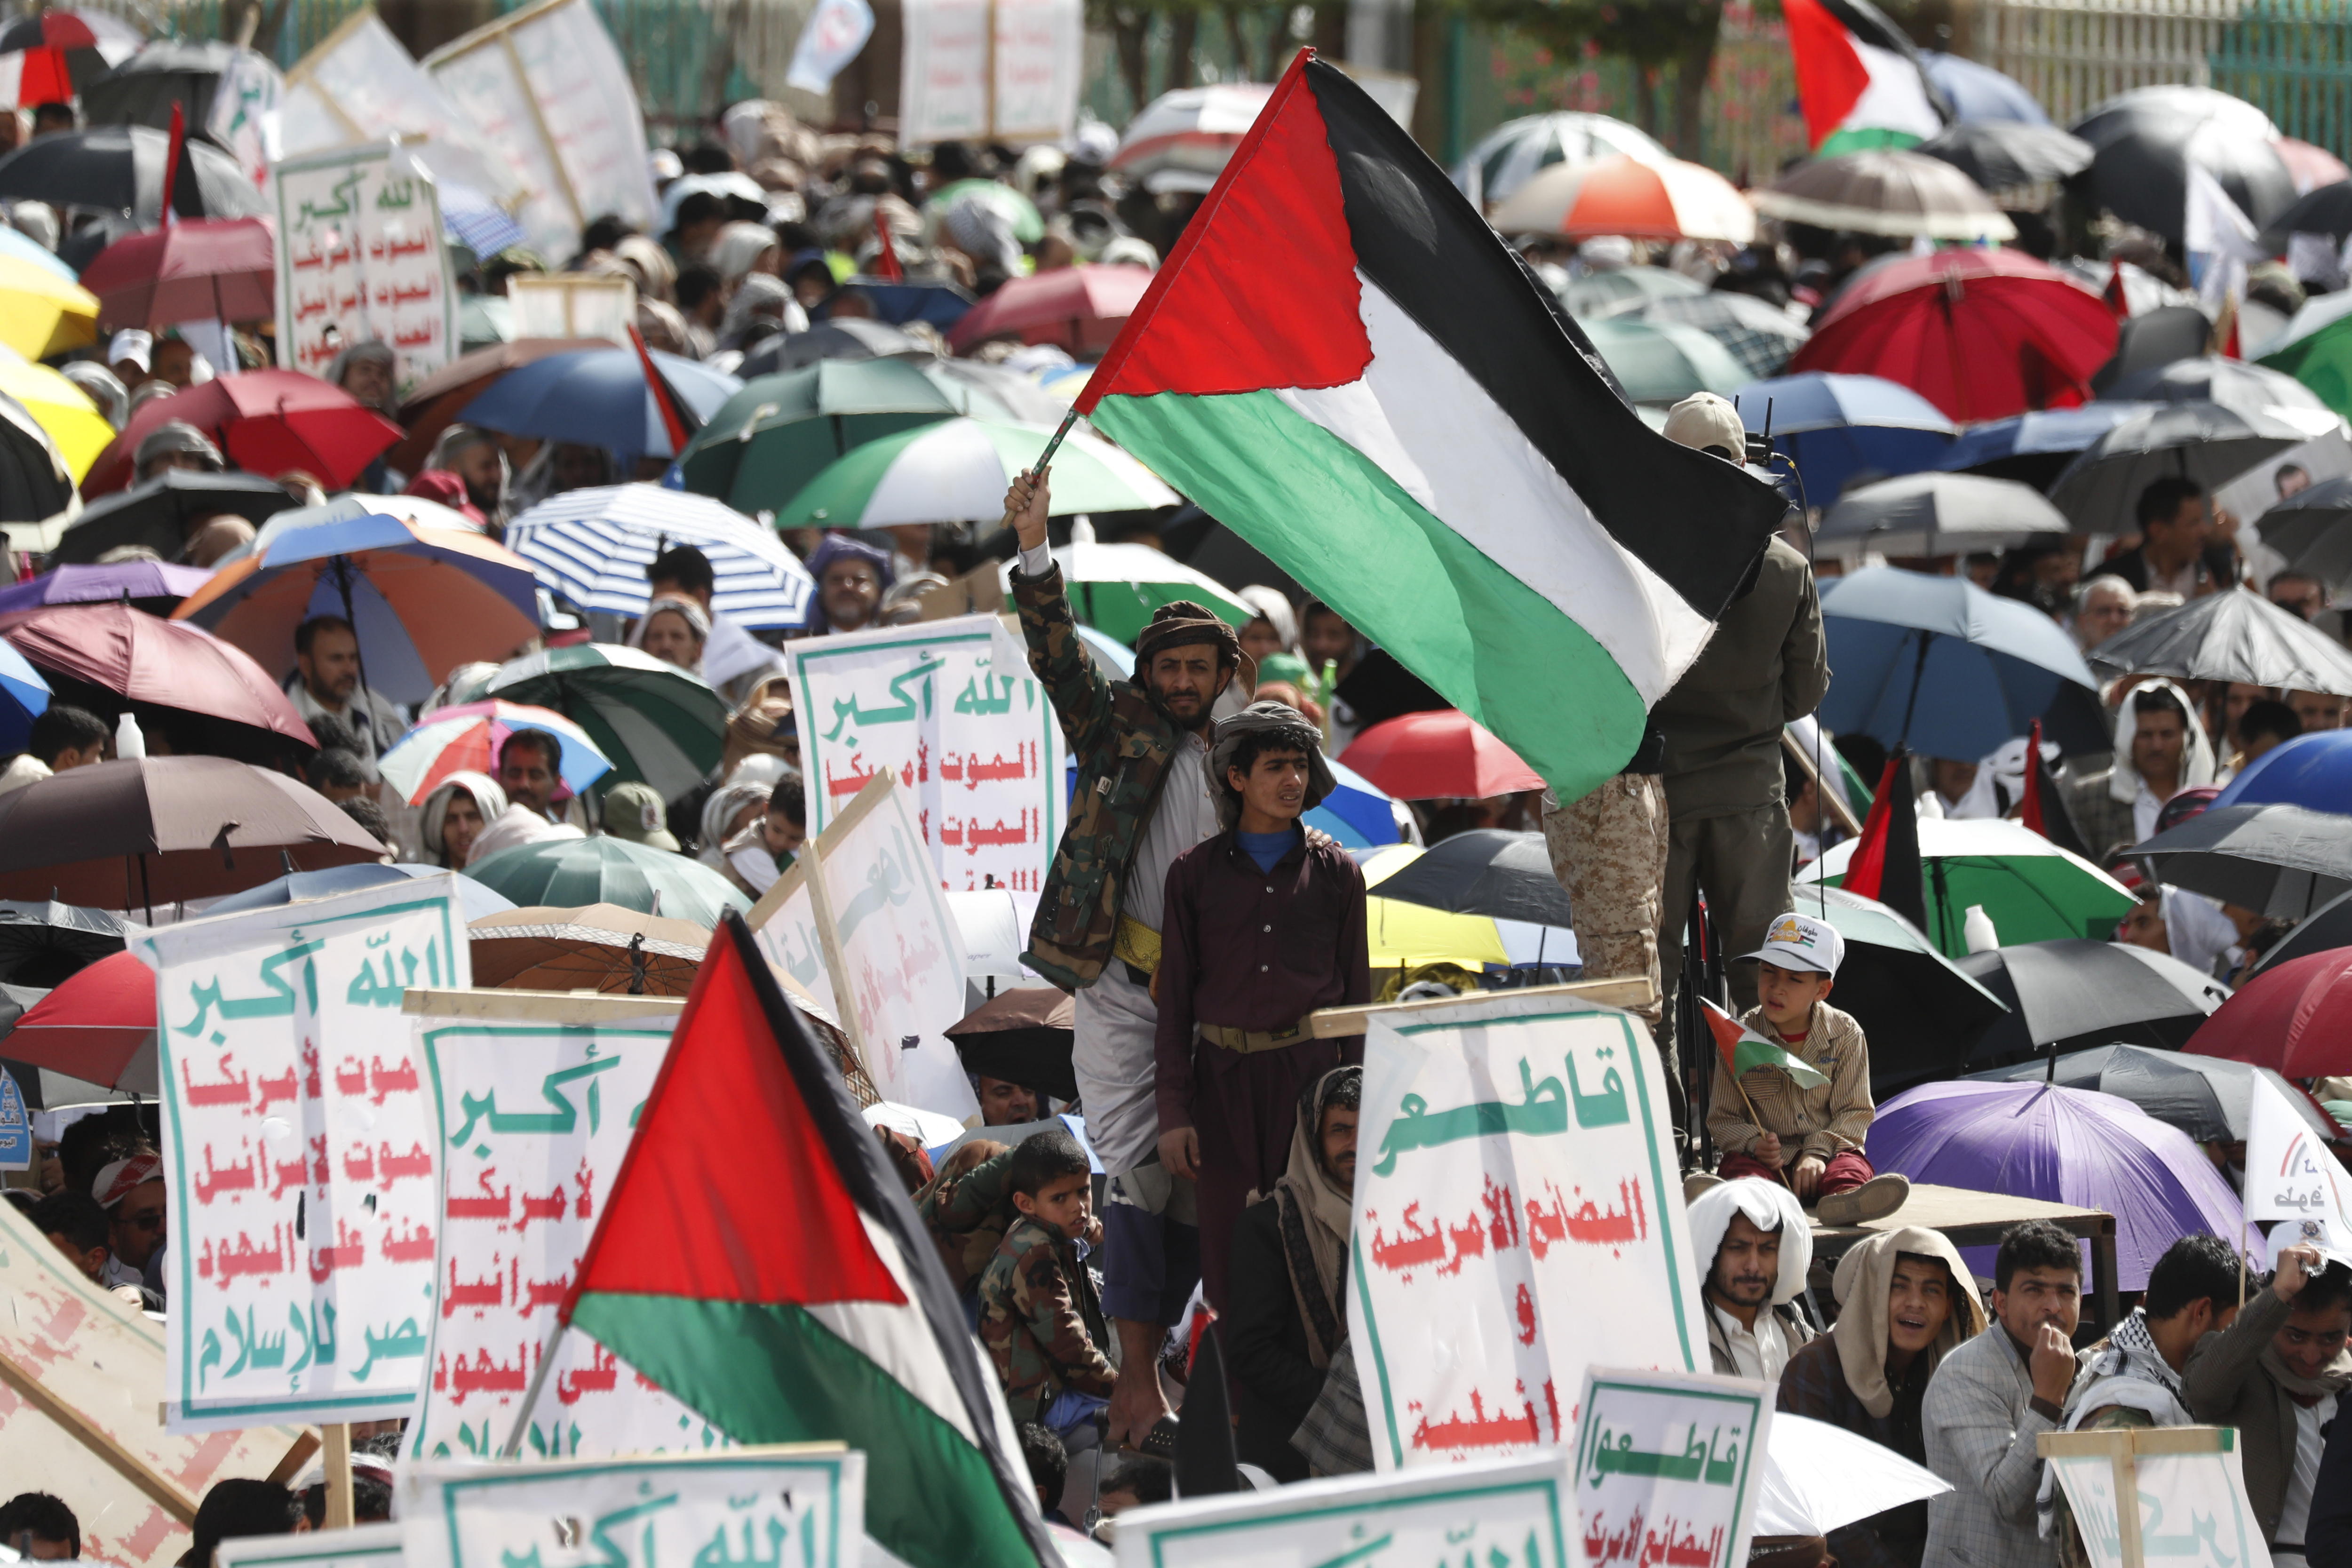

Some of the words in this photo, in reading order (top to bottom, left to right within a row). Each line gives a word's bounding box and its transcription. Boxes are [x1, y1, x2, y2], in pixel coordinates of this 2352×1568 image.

[821, 652, 945, 748] أكبر
[954, 659, 1034, 715] الله
[826, 737, 929, 797] لأميكا
[940, 741, 1037, 790] الموت
[940, 808, 1039, 855] الموت
[174, 930, 325, 1046] أكبر
[347, 932, 440, 1007] الله
[183, 1039, 321, 1115] لأمريكا
[336, 1056, 419, 1105] موت
[449, 1044, 621, 1159] أكبر
[1372, 1047, 1631, 1177] قاطعو
[195, 1134, 330, 1204] لإسرائيل
[344, 1142, 432, 1191] موت
[446, 1157, 594, 1233] لأمريكا
[309, 1219, 365, 1283] على
[1367, 1174, 1520, 1287] الأمريكية
[1525, 1178, 1646, 1260] البضائع
[199, 1222, 295, 1289] اليهود
[199, 1298, 336, 1393] للإسلام
[1516, 1283, 1536, 1345] و
[434, 1340, 541, 1406] اليهود
[1586, 1414, 1740, 1489] قاطعوا
